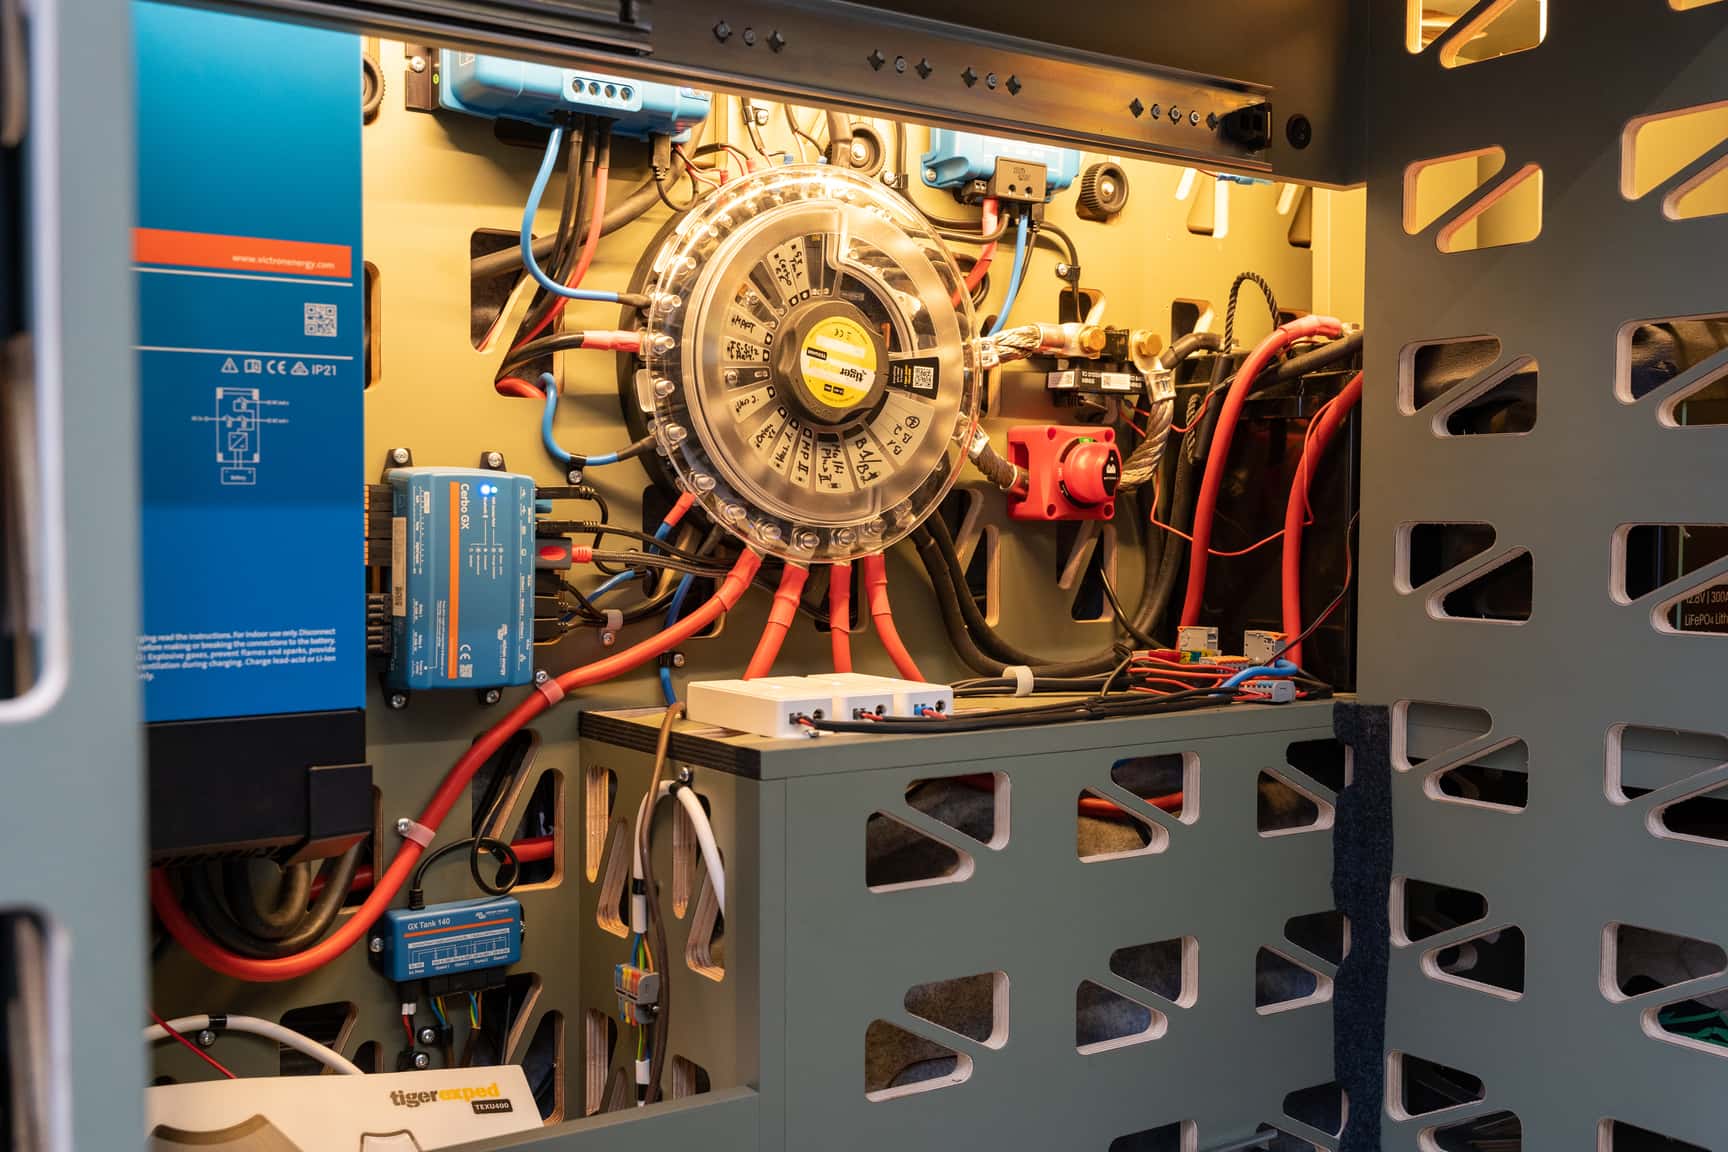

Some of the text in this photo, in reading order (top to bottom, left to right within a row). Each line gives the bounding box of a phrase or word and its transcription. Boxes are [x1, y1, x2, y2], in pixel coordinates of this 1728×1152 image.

[232, 255, 335, 270] www.victronenergy.com
[312, 364, 337, 376] IP21
[460, 483, 470, 529] Cerbo GX
[420, 919, 437, 929] Tank
